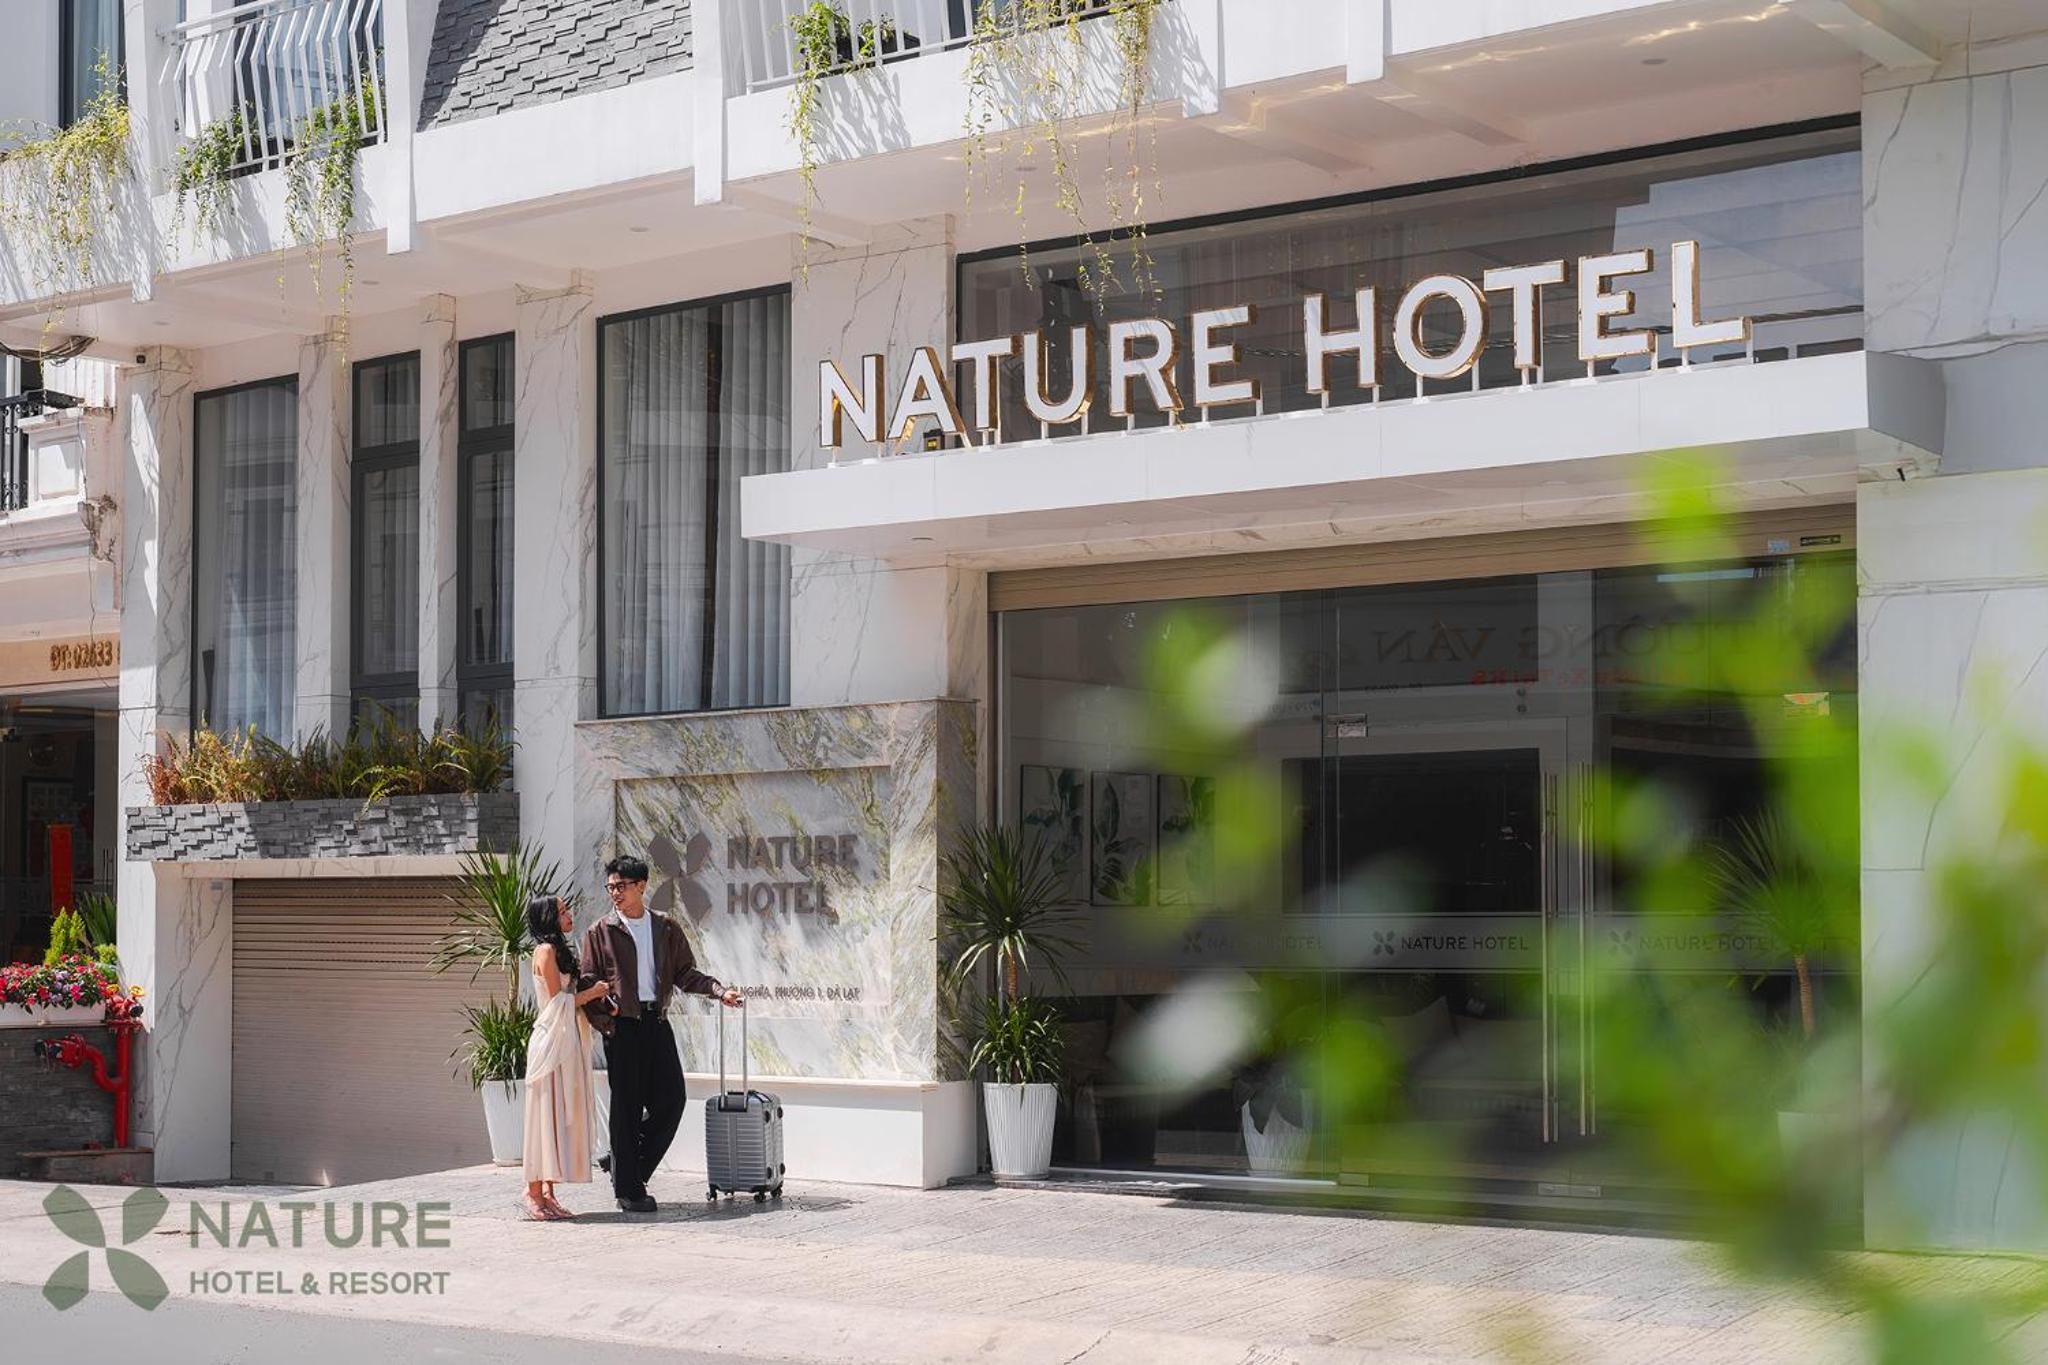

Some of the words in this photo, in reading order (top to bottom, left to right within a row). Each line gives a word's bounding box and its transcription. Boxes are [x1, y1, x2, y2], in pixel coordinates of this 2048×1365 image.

[819, 304, 1259, 449] NATURE
[1304, 240, 1749, 393] HOTEL
[727, 835, 859, 868] NATURE
[727, 881, 833, 914] HOTEL
[1401, 936, 1467, 951] NATURE
[1473, 936, 1528, 951] HOTEL
